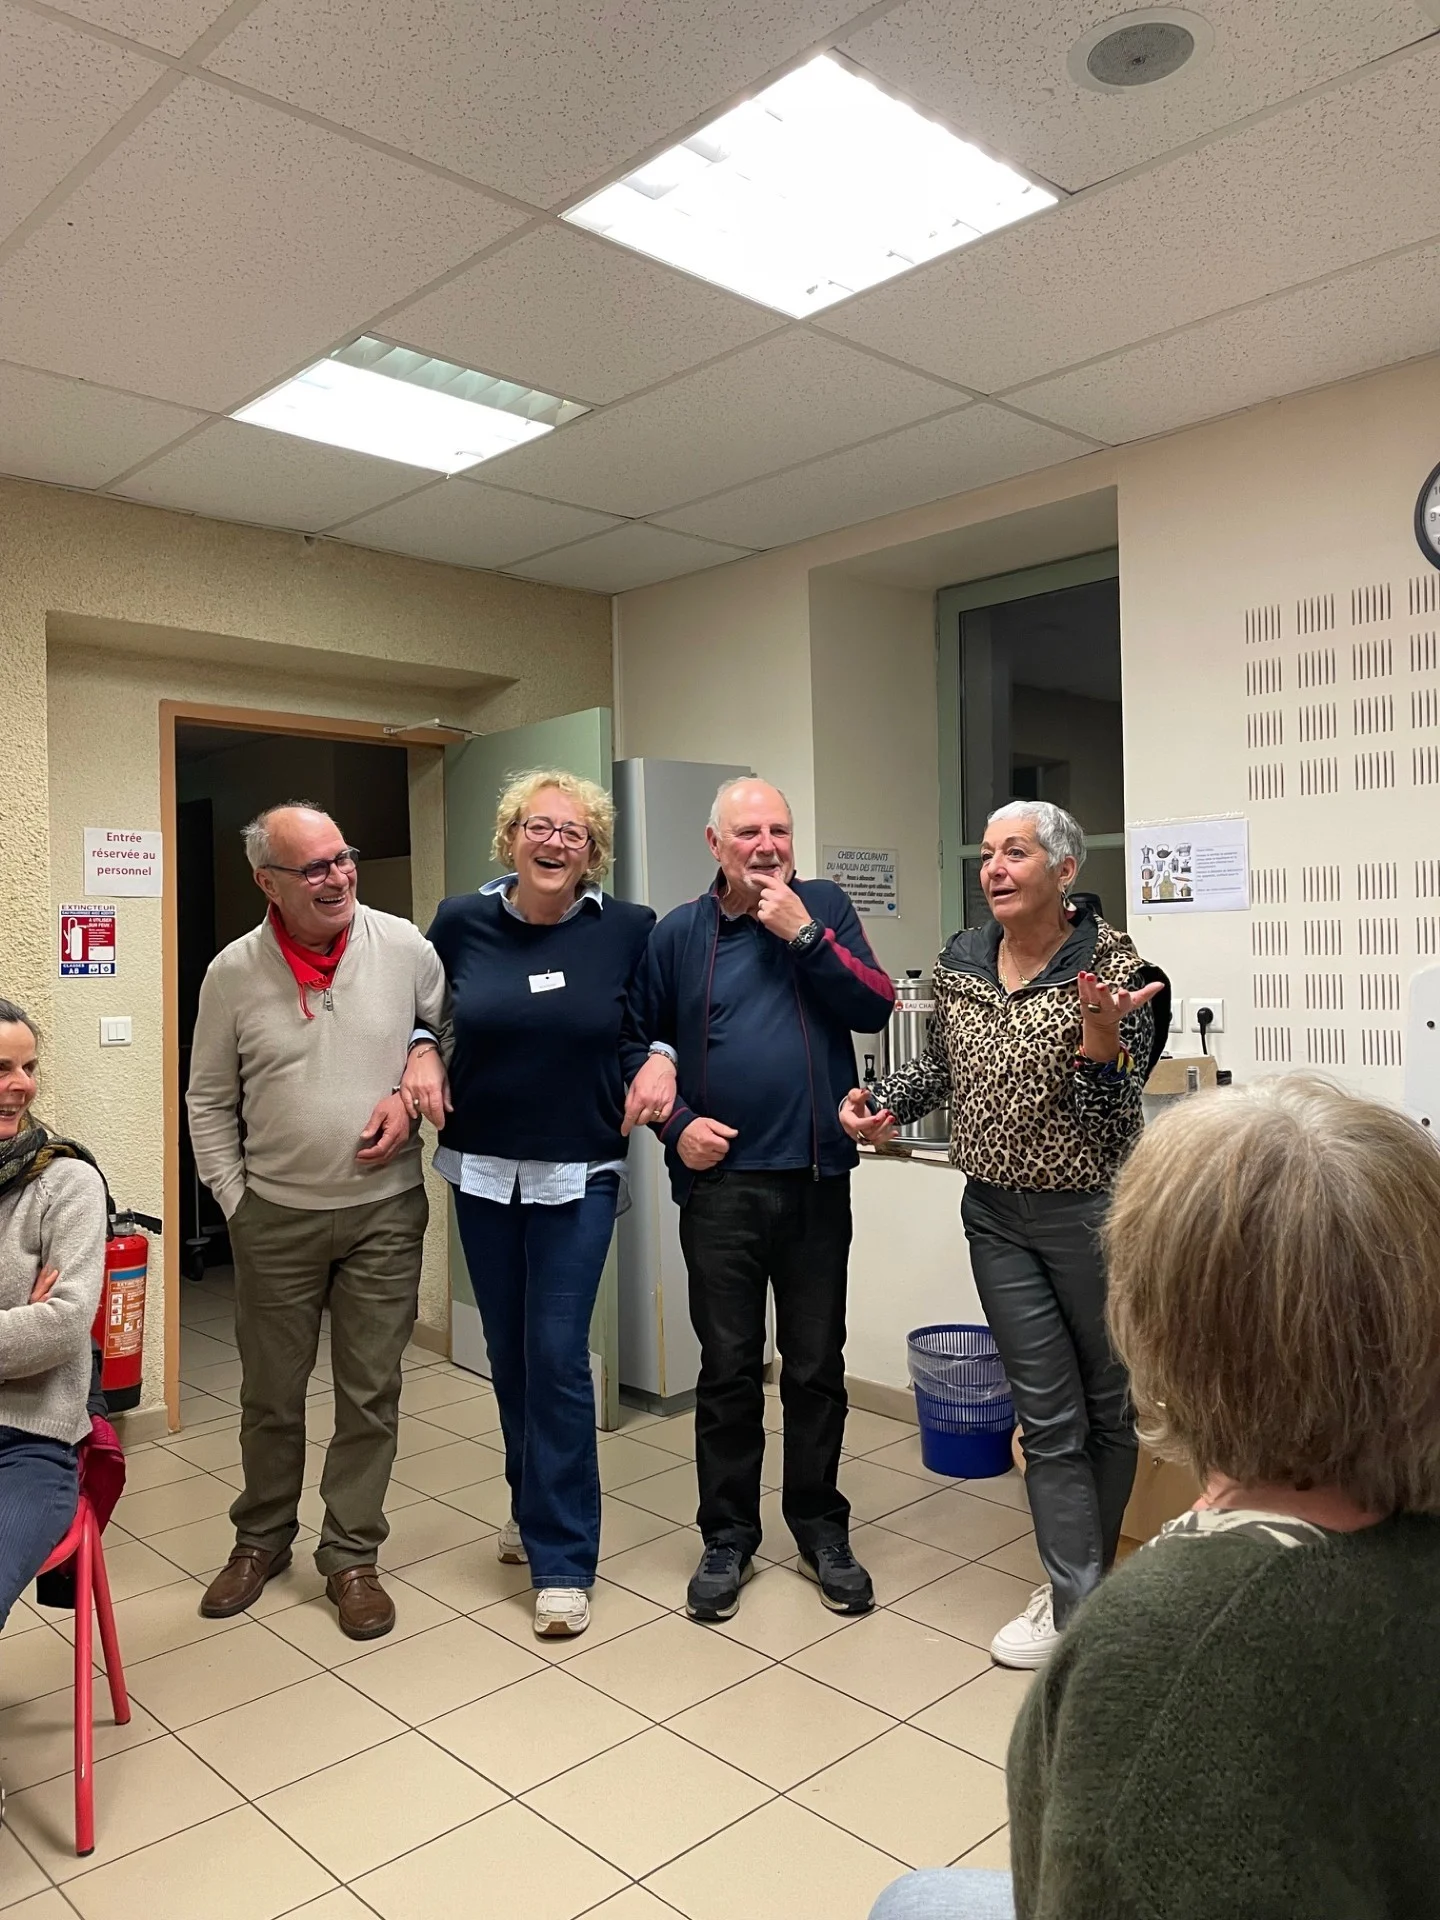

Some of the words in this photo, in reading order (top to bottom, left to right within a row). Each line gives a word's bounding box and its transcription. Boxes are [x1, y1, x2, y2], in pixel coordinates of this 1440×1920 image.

[1430, 512, 1437, 522] 9
[106, 832, 142, 842] Entrée
[92, 848, 140, 859] réservée
[142, 852, 156, 860] au
[837, 850, 856, 860] CHERS
[856, 851, 889, 861] OCCUPANTS
[97, 866, 152, 877] personnel
[826, 862, 836, 870] DU
[836, 862, 859, 871] MOULIN
[860, 863, 870, 872] DES
